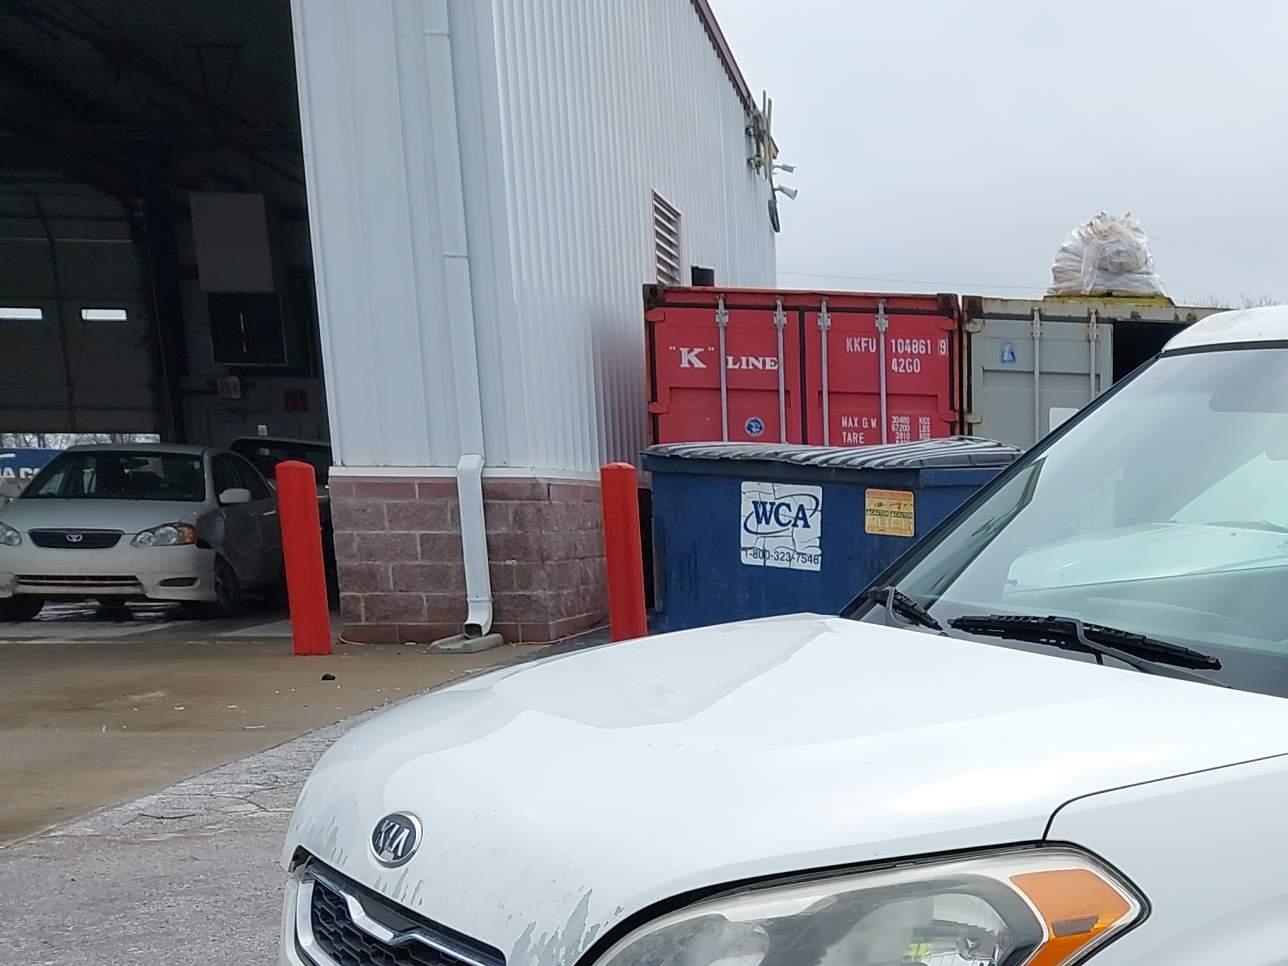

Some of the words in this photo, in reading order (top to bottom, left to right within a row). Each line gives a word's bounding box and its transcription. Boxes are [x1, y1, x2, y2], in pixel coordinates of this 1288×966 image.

[846, 337, 877, 353] KKFU
[890, 339, 932, 354] 104861
[726, 355, 779, 370] LINE
[841, 416, 859, 428] MAX
[841, 431, 865, 444] TARE
[752, 501, 811, 528] WCA
